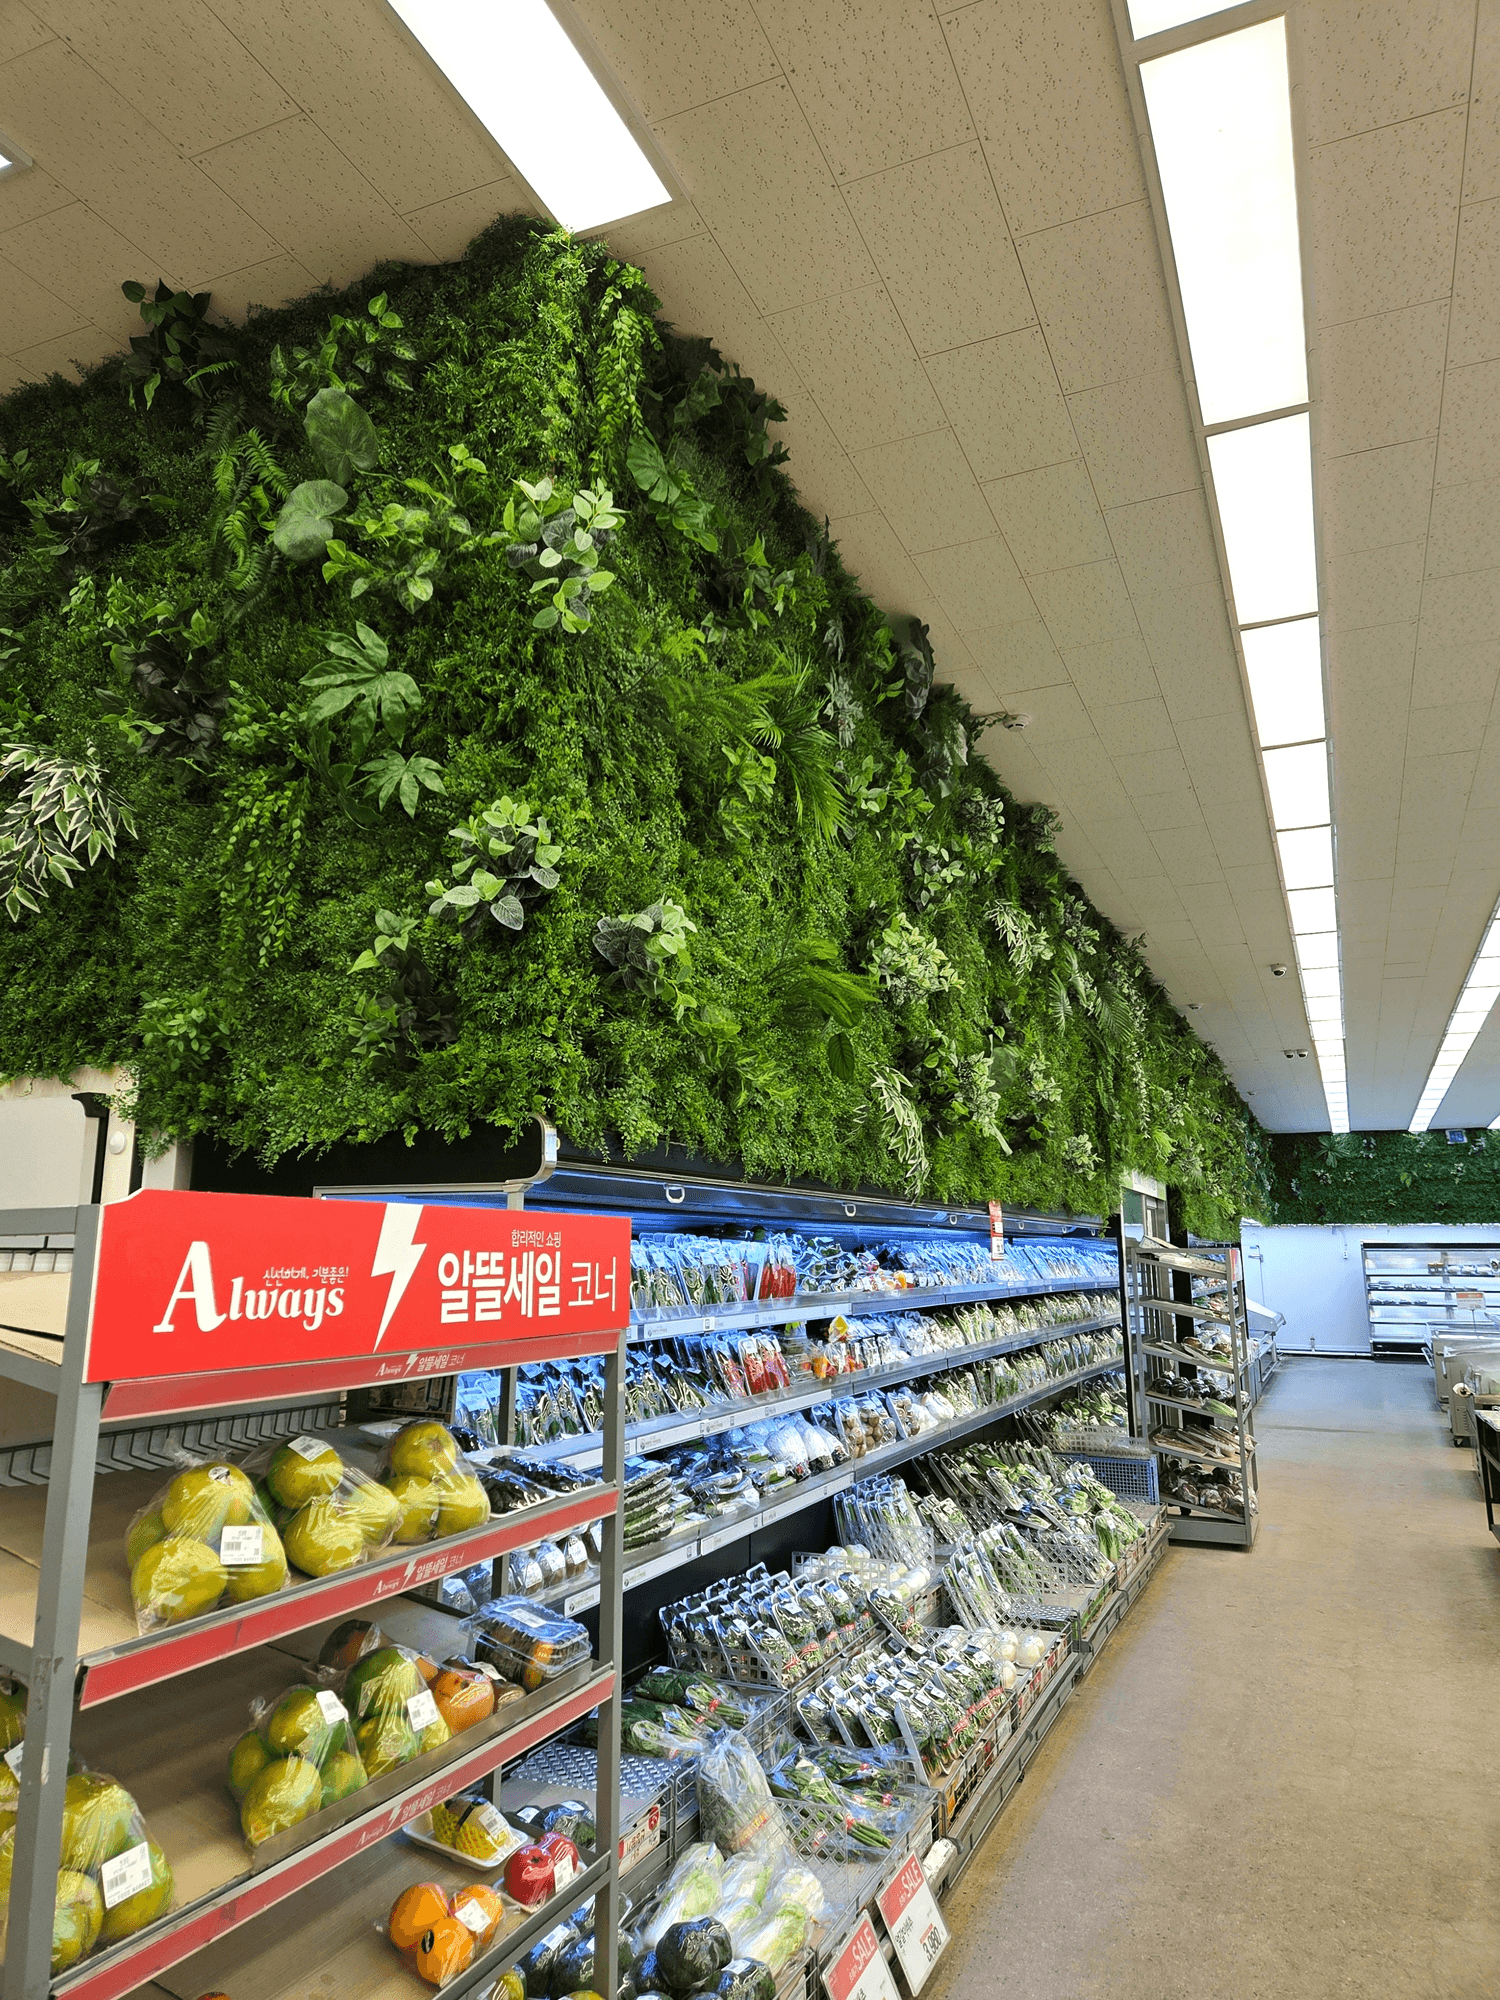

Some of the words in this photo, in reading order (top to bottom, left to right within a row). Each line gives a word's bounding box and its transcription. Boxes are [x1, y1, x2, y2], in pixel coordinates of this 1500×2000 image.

[510, 1229, 544, 1248] 합리적인
[545, 1231, 561, 1248] 쇼핑
[152, 1240, 345, 1333] Always
[437, 1249, 561, 1324] 알뜰세일
[567, 1256, 617, 1312] 코너
[416, 1353, 450, 1372] 알뜰세일
[448, 1352, 466, 1367] 코너
[415, 1555, 449, 1582] 알뜰세일
[447, 1550, 465, 1569] 코너
[900, 1860, 922, 1898] SALE
[851, 1925, 876, 1971] SALE
[922, 1925, 942, 1963] 3,980
